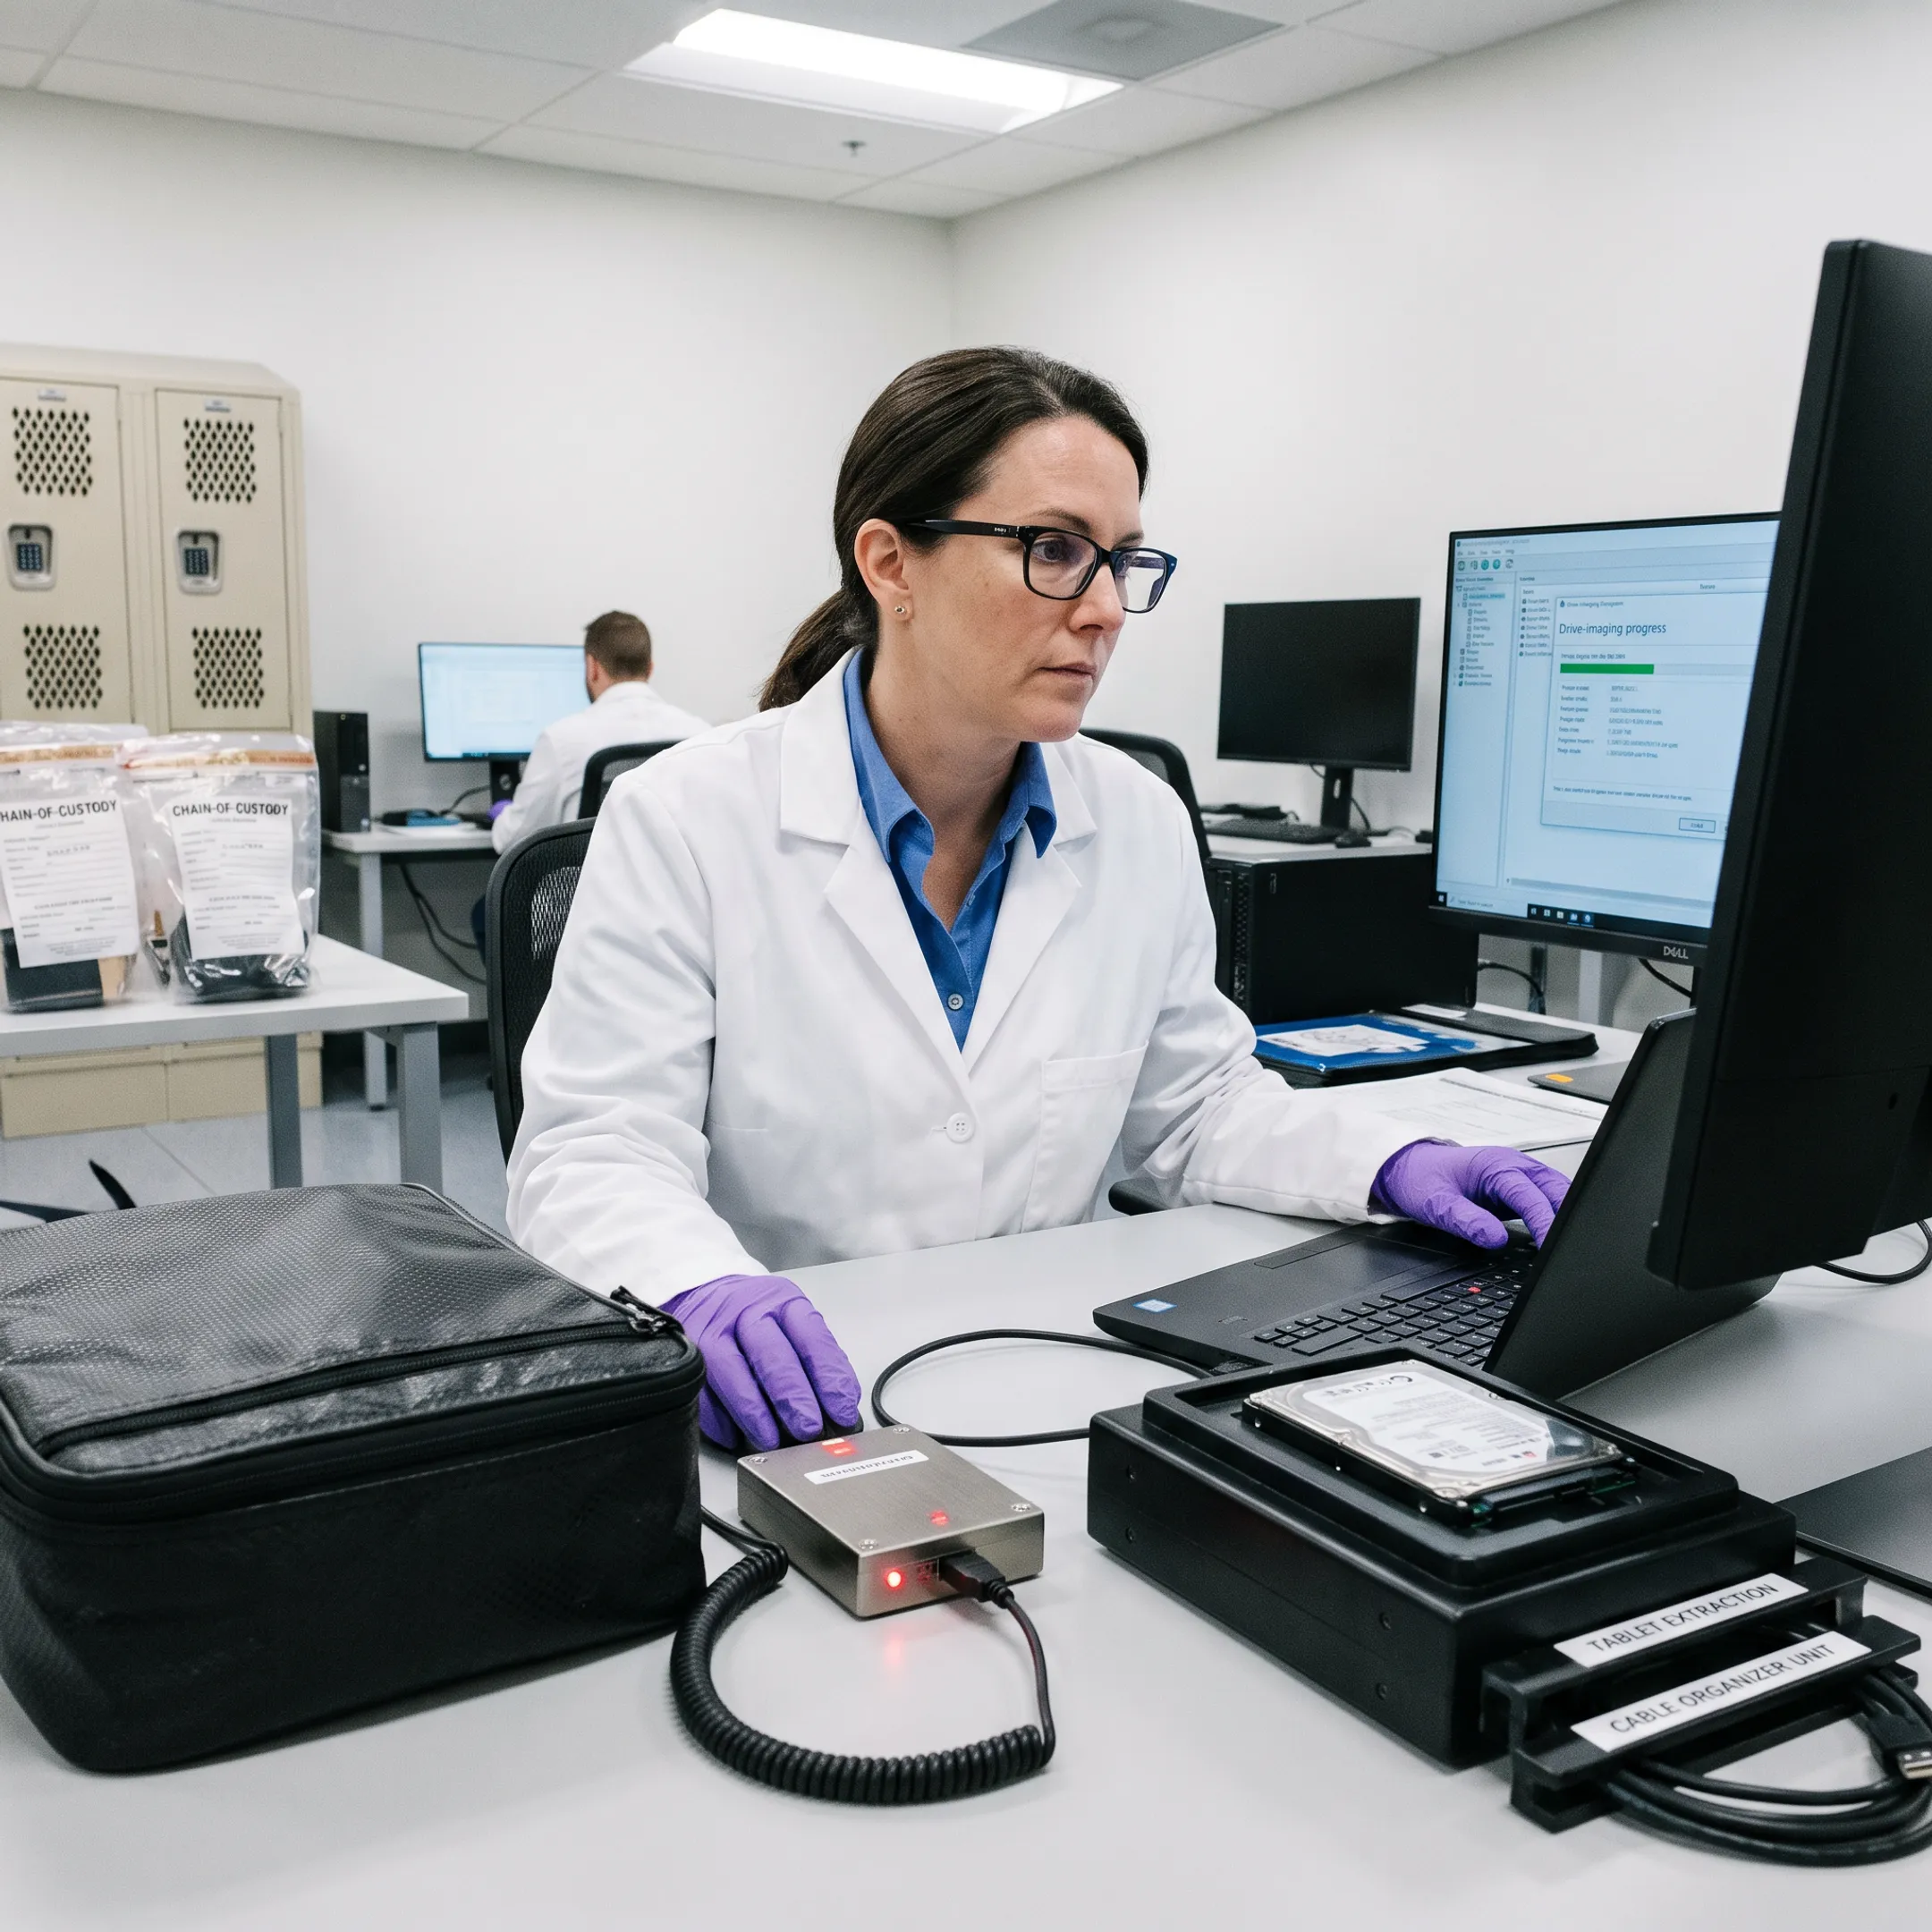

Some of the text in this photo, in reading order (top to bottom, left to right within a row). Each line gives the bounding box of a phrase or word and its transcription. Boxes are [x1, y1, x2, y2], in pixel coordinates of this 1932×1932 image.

[1559, 623, 1666, 638] Drive-imaging progress
[1587, 1583, 1779, 1652] TABLET EXTRACTION
[1610, 1644, 1835, 1733] CABLE ORGANIZER UNIT
